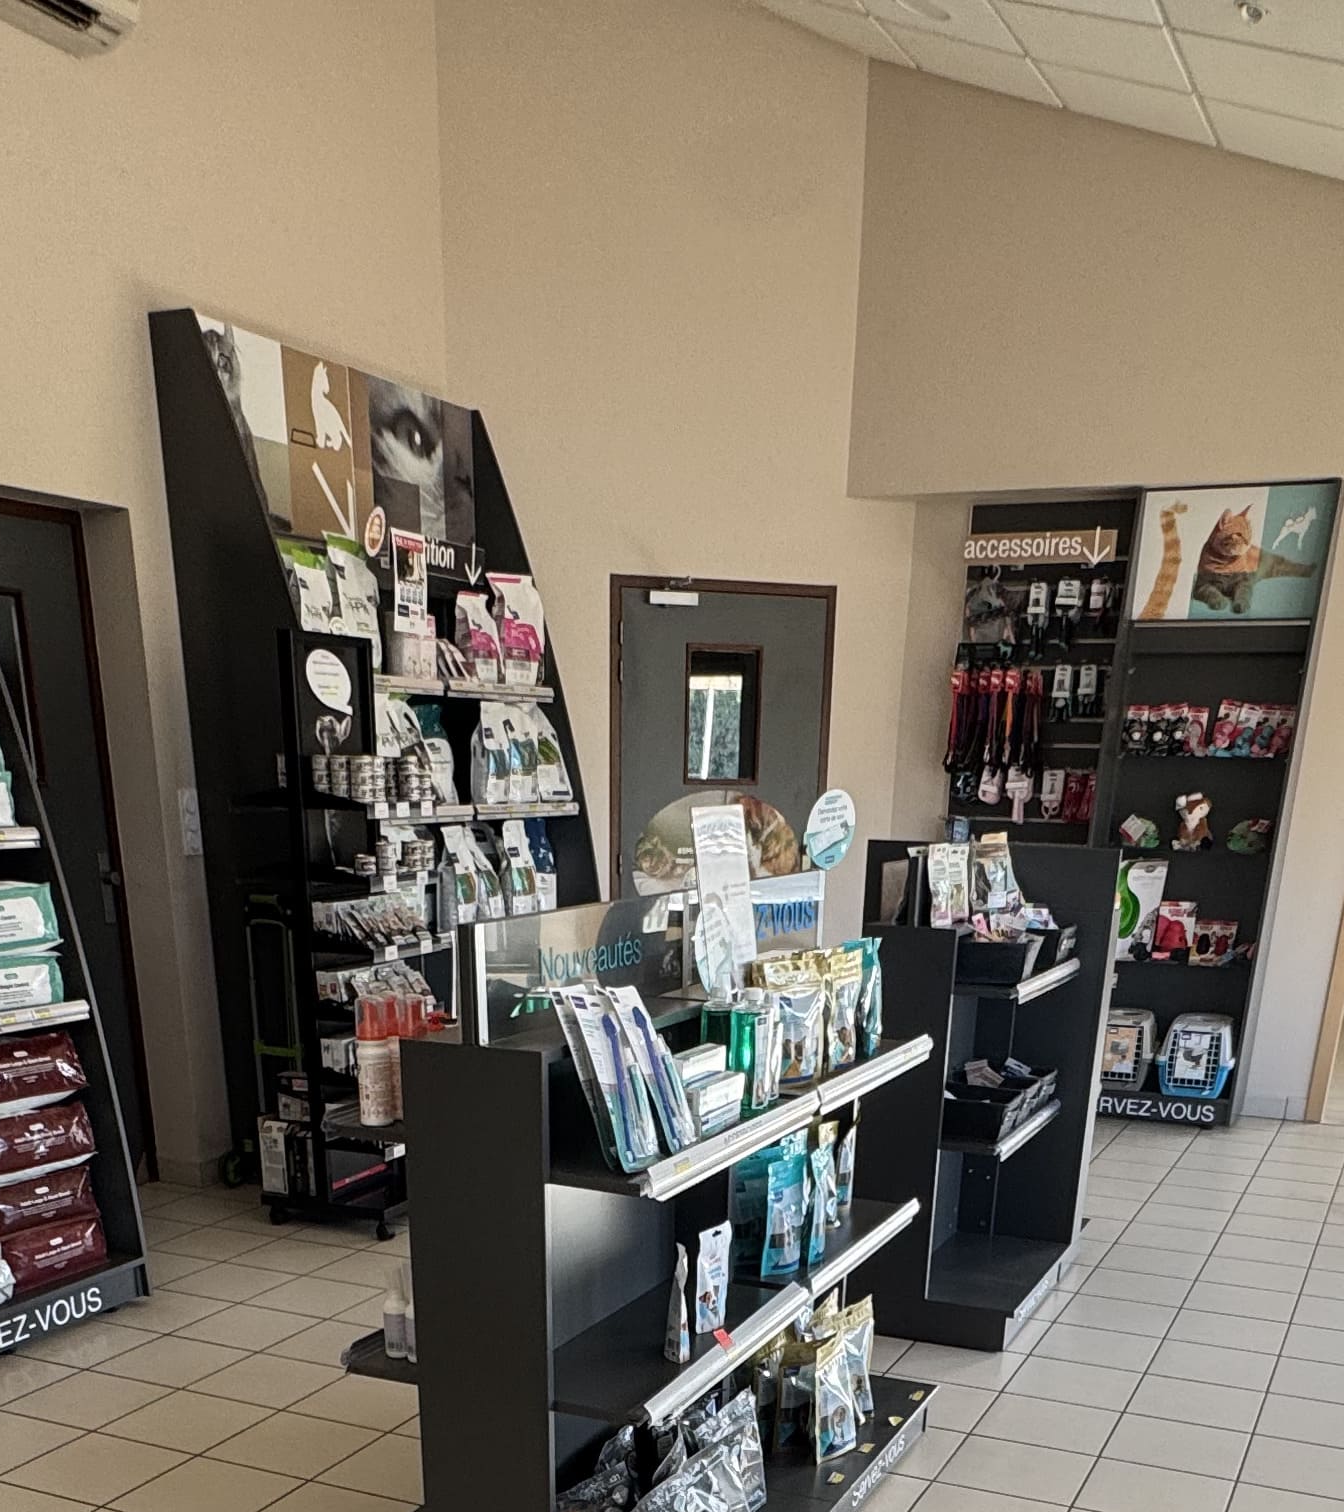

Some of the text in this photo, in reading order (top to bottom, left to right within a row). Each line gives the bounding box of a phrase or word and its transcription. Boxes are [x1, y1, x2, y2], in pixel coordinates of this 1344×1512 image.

[425, 538, 456, 572] ition
[964, 532, 1082, 560] accessoires
[756, 896, 816, 941] Z-VOUS
[539, 933, 642, 984] Nouveautés
[1097, 1096, 1215, 1122] RVEZ-VOUS
